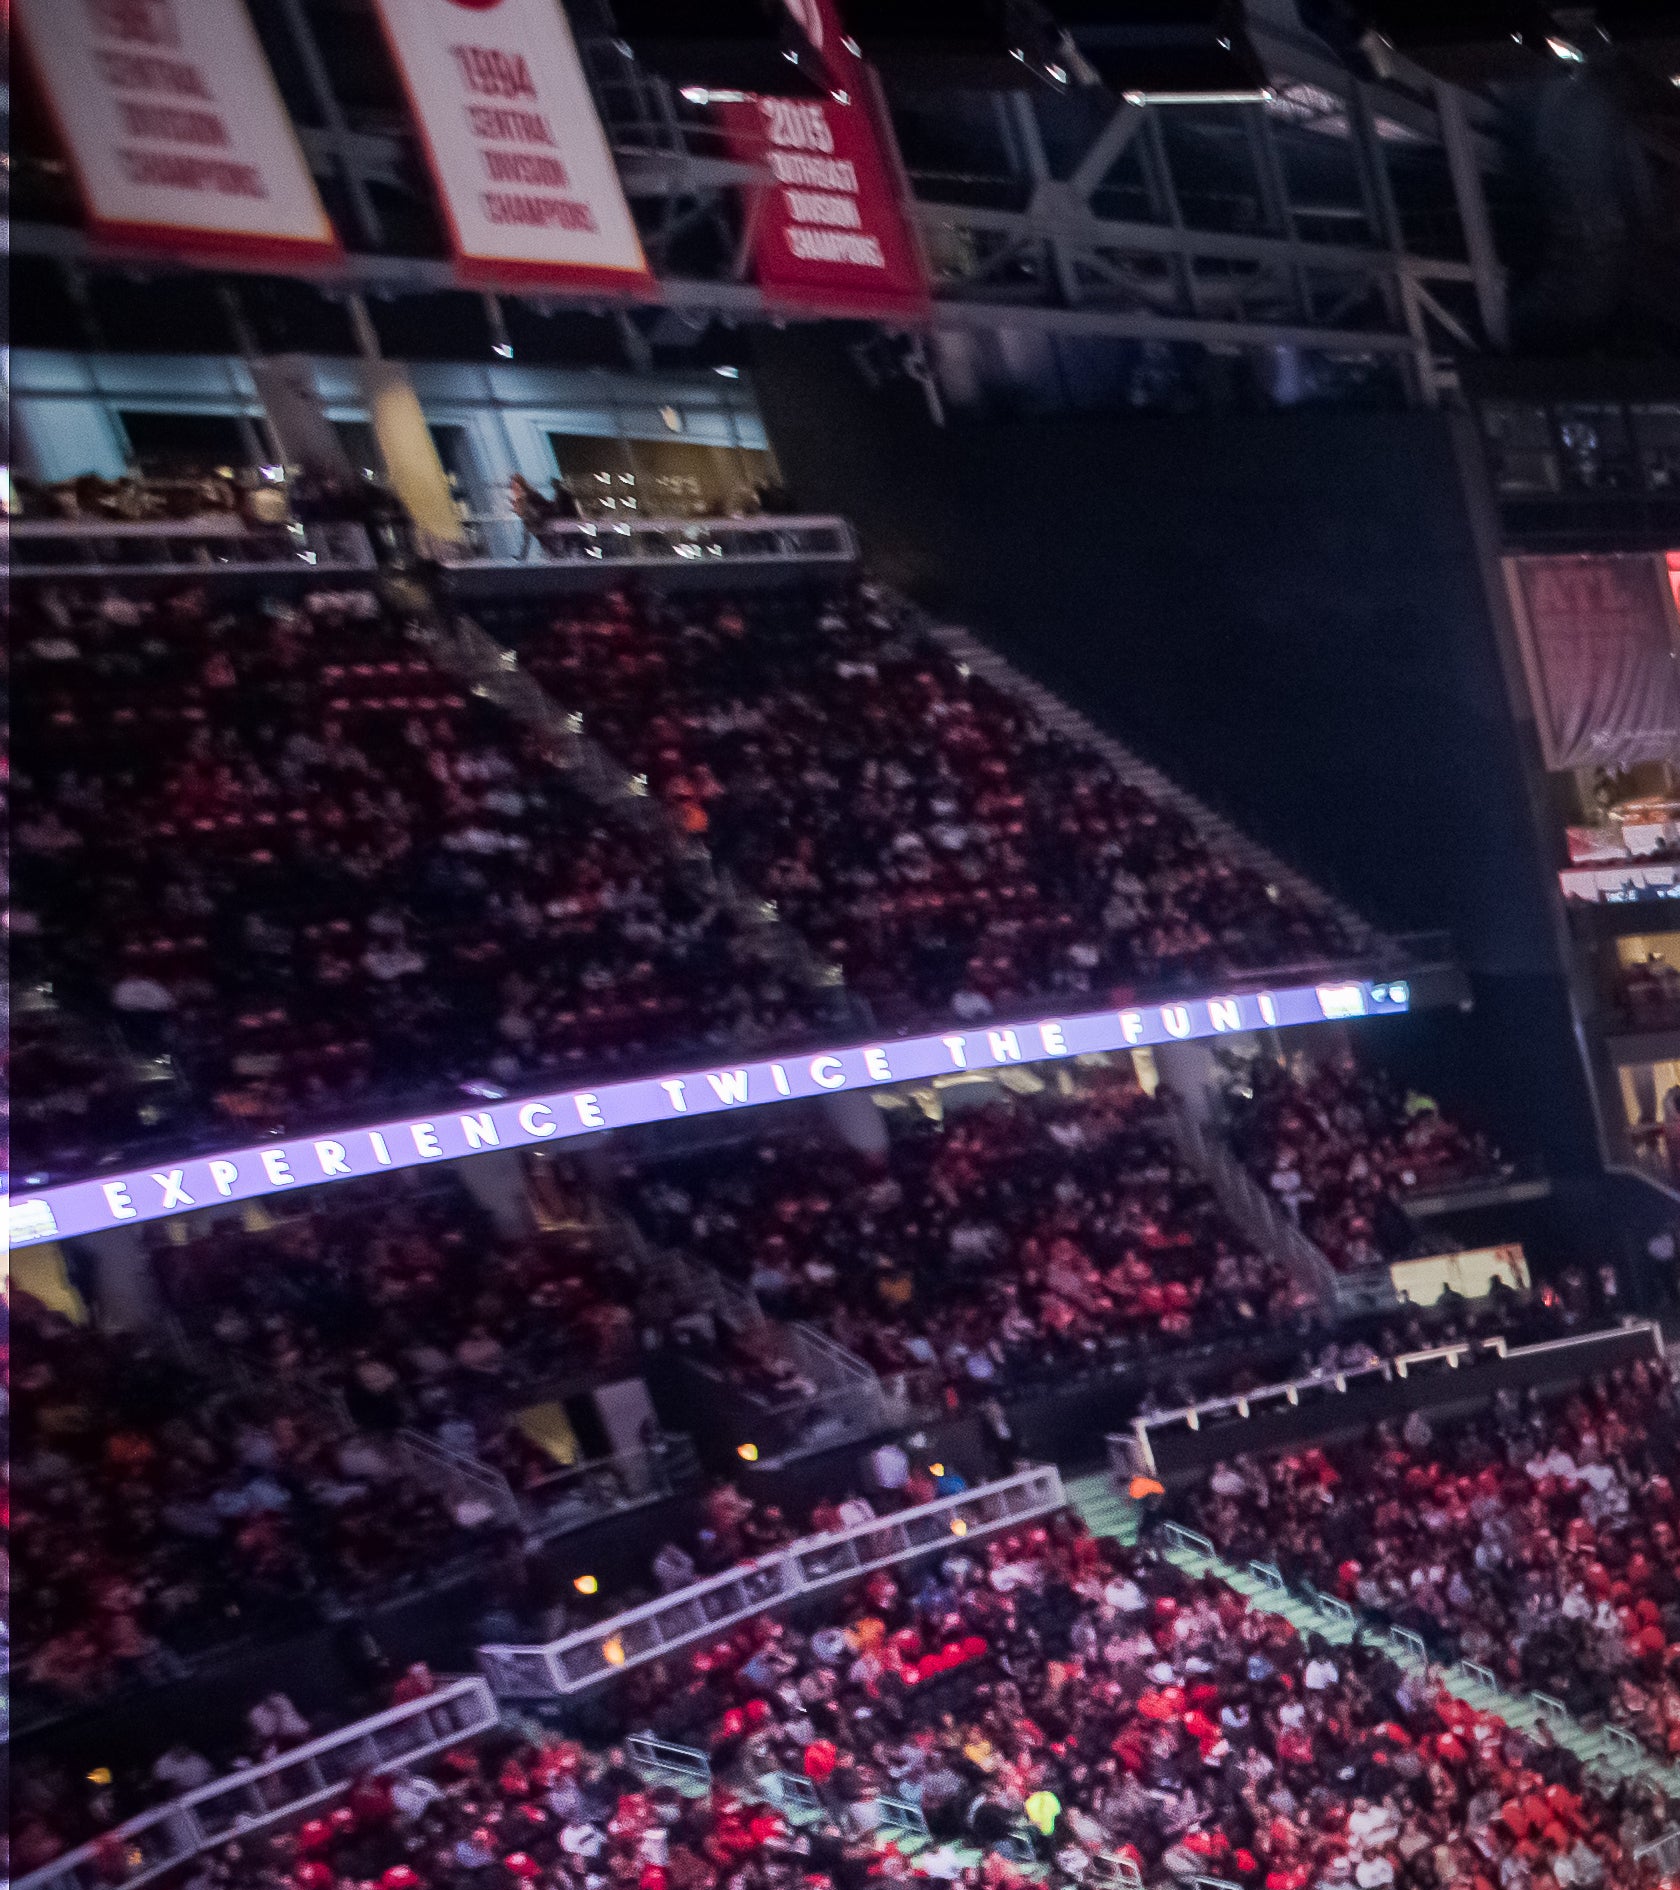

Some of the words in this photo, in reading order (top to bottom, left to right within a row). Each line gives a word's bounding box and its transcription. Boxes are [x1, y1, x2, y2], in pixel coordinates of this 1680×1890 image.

[451, 43, 538, 100] 1994
[760, 98, 834, 154] 2015
[102, 1093, 606, 1220] EXPERIENCE
[660, 1048, 893, 1112] TWICE
[943, 1021, 1068, 1068] THE
